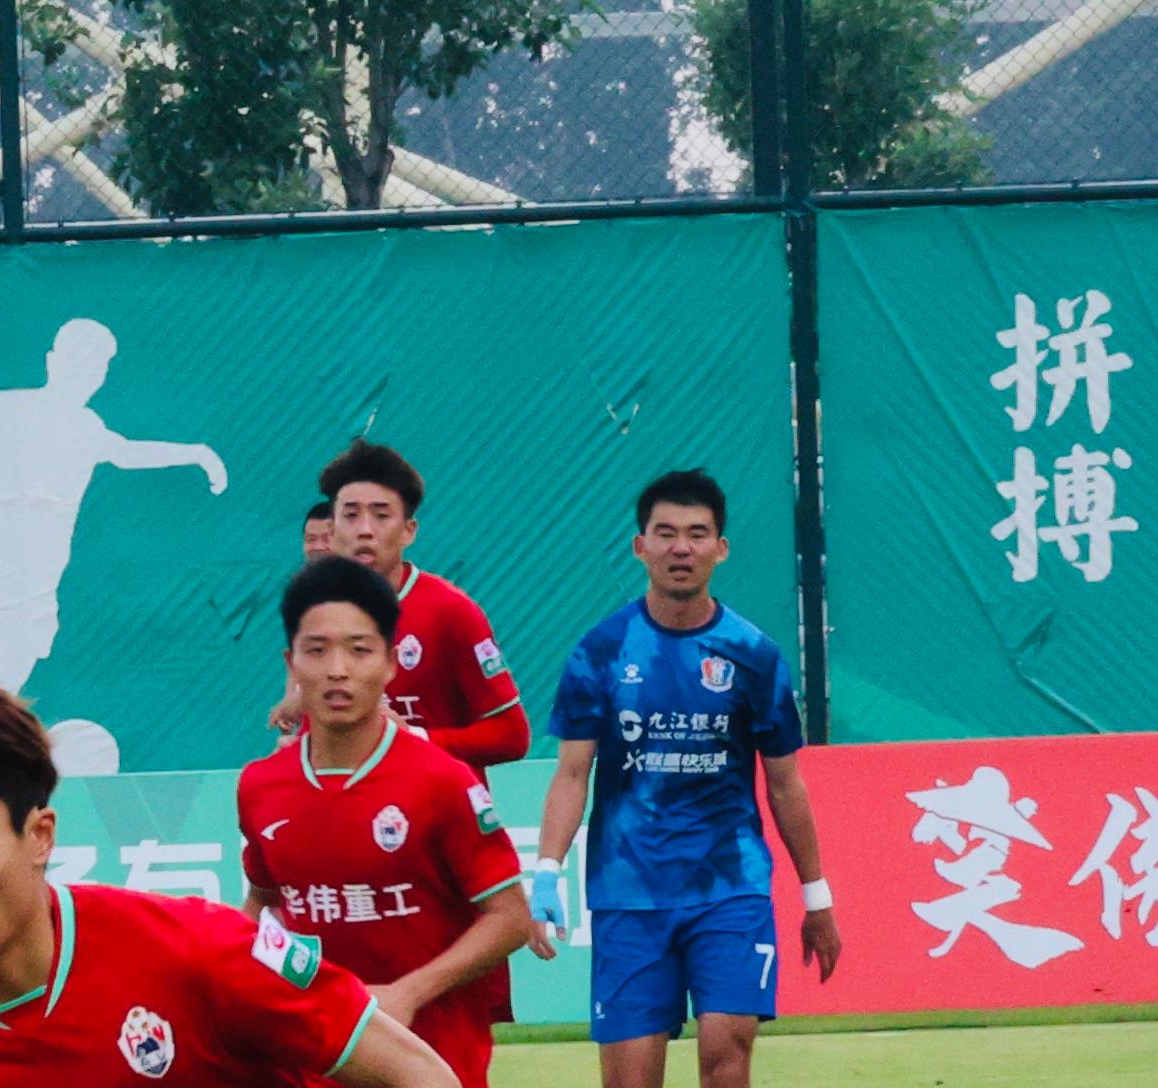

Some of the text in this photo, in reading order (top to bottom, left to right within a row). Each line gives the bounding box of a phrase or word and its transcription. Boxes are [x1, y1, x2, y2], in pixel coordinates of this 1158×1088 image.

[990, 289, 1139, 582] 拼搏
[648, 711, 730, 734] 九江银行
[754, 943, 775, 990] 7
